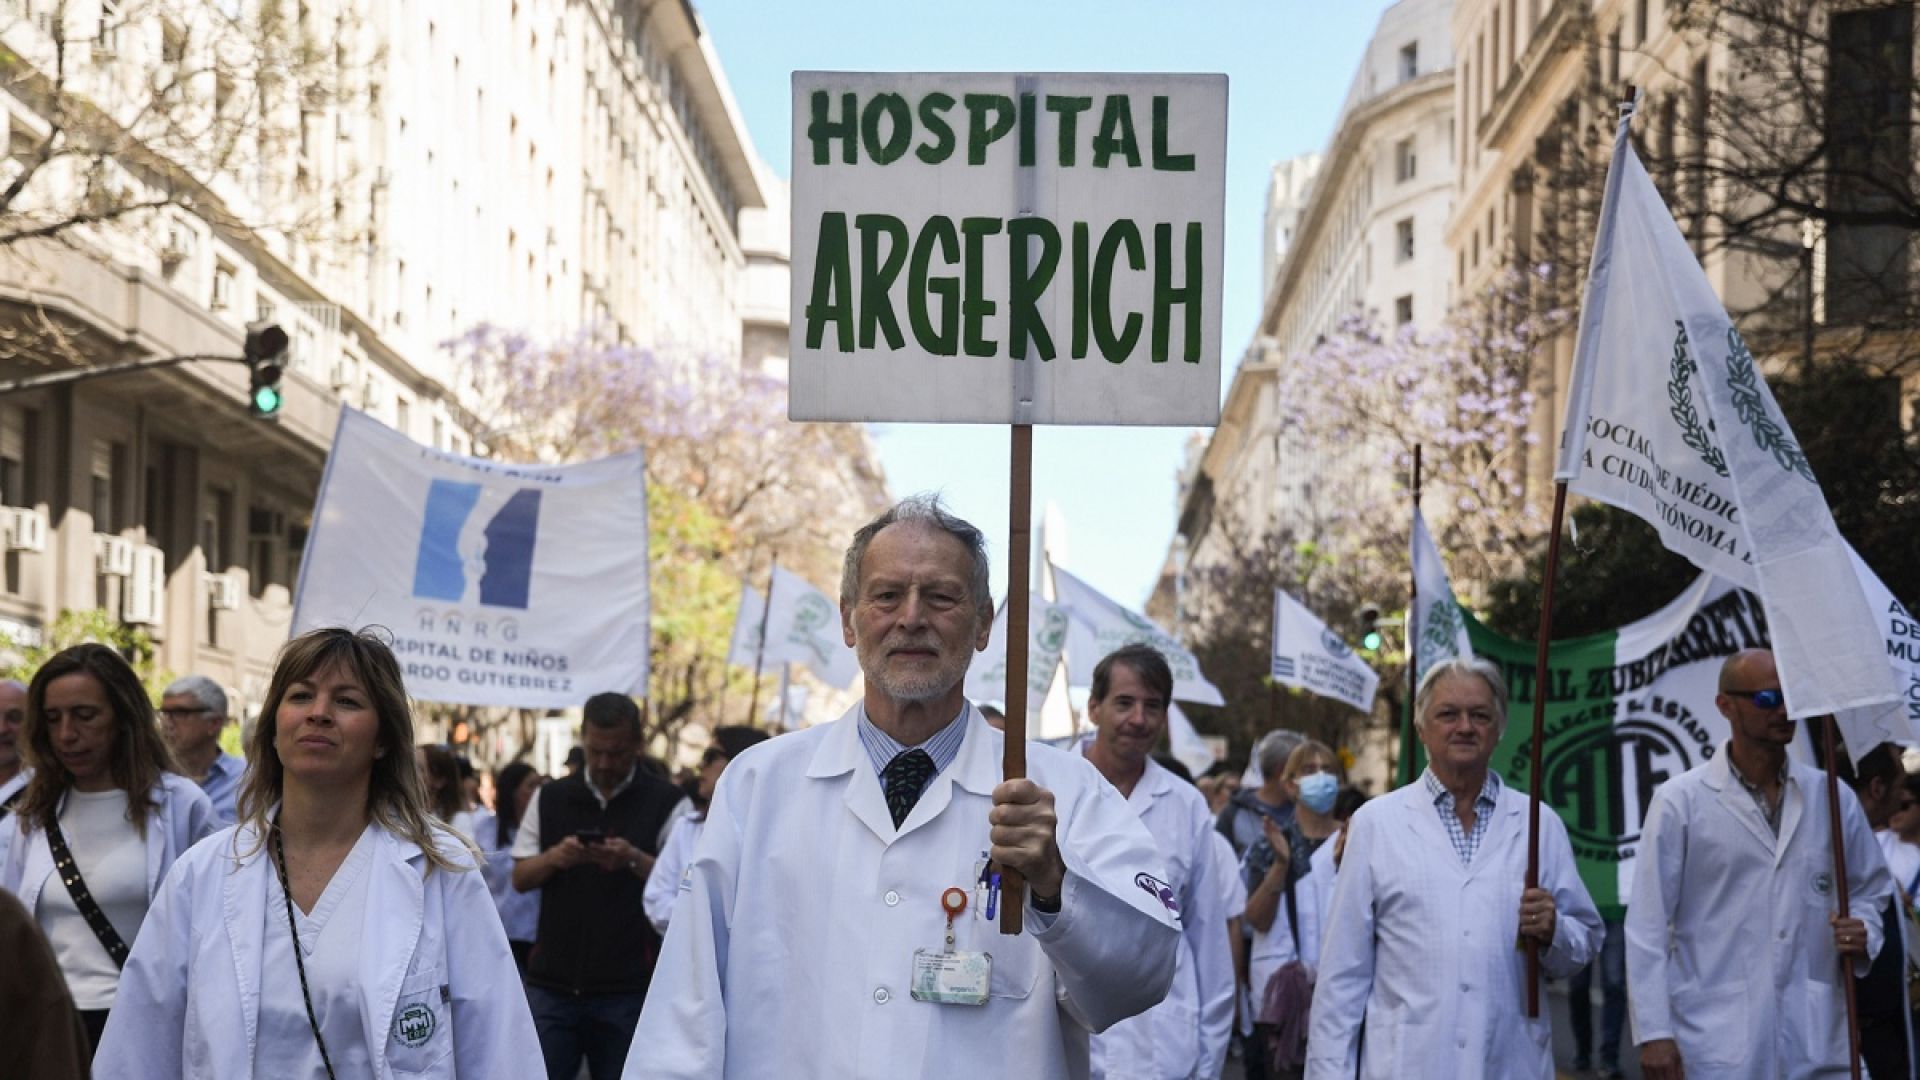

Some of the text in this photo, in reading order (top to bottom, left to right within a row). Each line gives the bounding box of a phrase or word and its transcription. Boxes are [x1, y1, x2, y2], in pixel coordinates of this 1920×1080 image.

[808, 90, 1196, 171] HOSPITAL
[806, 211, 1202, 364] ARGERICH
[457, 667, 574, 692] GUTIERREZ
[469, 648, 495, 665] DE
[503, 650, 568, 672] NIÑOS
[1652, 696, 1715, 760] ESTADO
